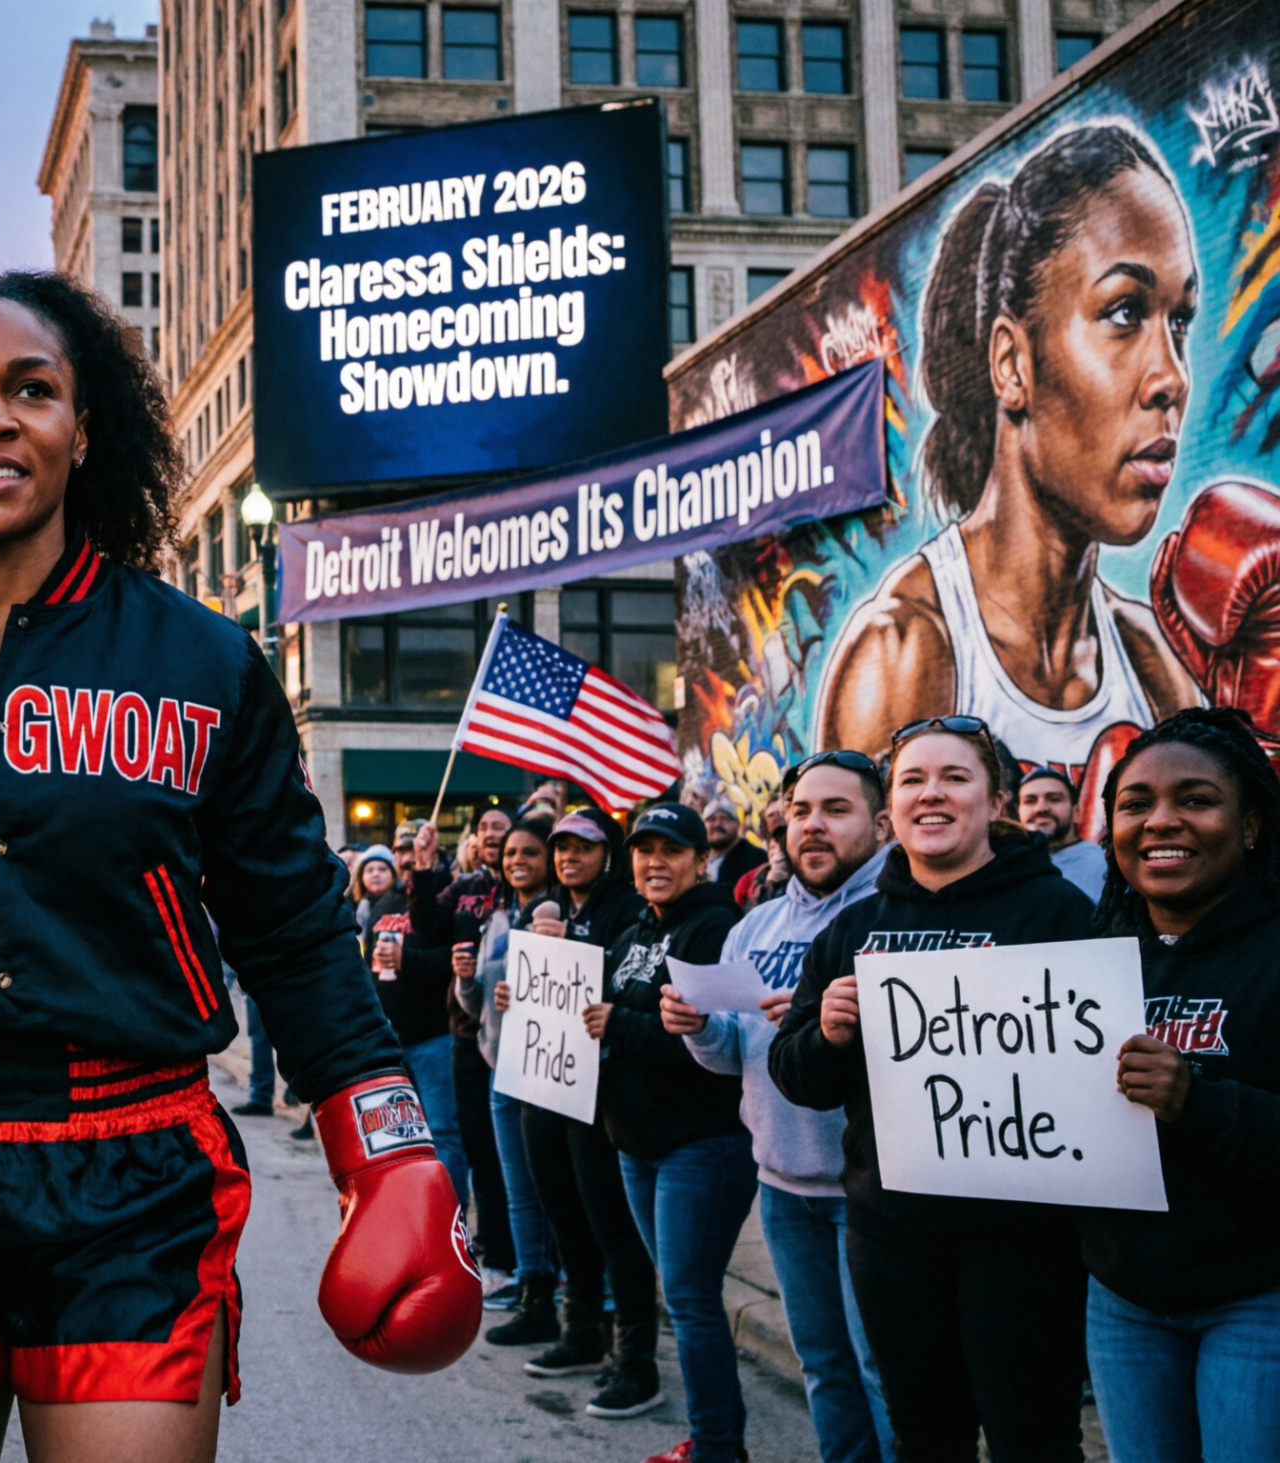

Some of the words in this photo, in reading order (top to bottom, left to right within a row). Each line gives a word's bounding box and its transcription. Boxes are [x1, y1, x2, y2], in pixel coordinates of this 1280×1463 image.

[321, 173, 487, 236] FEBRUARY
[494, 161, 587, 214] 2026
[284, 251, 453, 311] Claressa
[462, 224, 626, 290] Shields:
[320, 286, 585, 361] Homecoming
[339, 350, 570, 415] Showdown.
[304, 526, 403, 602] Detroit
[408, 506, 569, 586] Welcomes
[577, 482, 624, 556] Its
[633, 428, 835, 542] Champion.
[3, 684, 221, 796] GWOAT
[516, 949, 594, 1016] Detroit's
[880, 967, 1105, 1063] Detroit's
[523, 1019, 576, 1087] Pride
[924, 1072, 1084, 1162] Pride.
